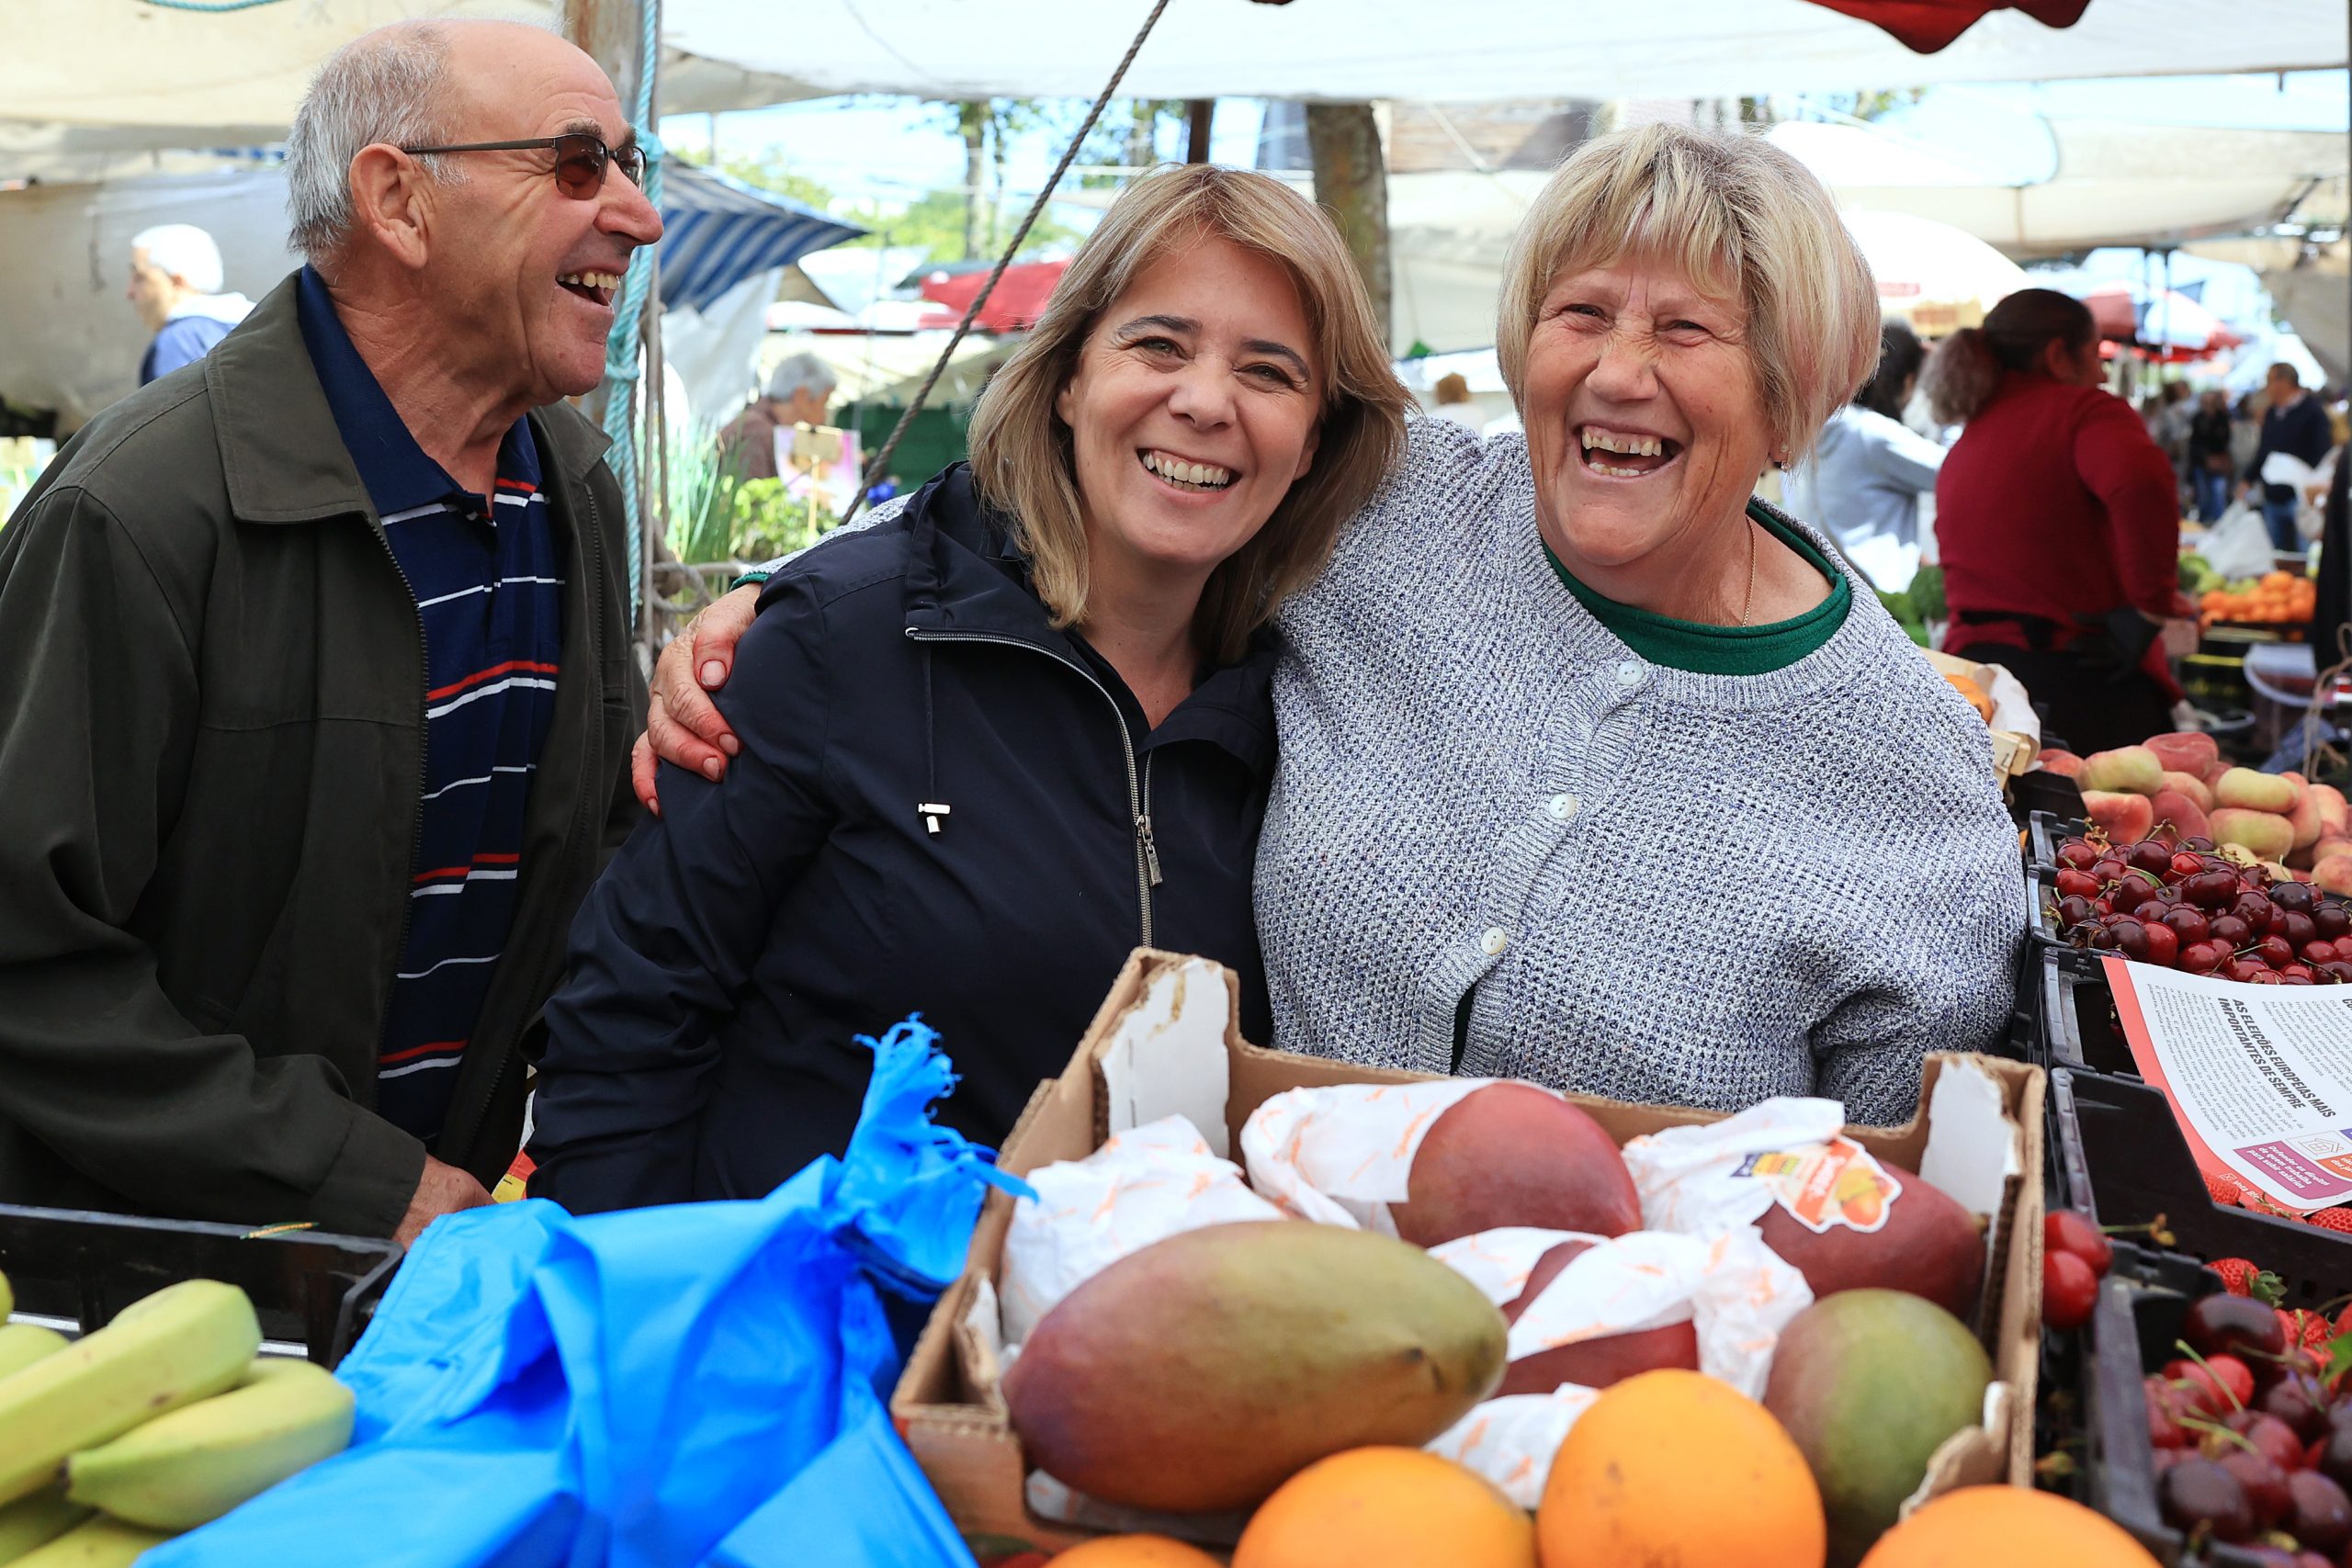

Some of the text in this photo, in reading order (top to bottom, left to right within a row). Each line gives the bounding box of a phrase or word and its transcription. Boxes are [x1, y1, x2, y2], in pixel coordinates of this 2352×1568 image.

[2219, 998, 2305, 1108] IMPORTANTES DE SEMPRE
[2233, 999, 2335, 1117] AS ELEIÇÕES EUROPEIAS MAIS
[2246, 1150, 2305, 1189] para subir salários
[2267, 1154, 2286, 1166] quem
[2285, 1166, 2312, 1185] trabalha
[2268, 1146, 2297, 1165] Defender
[2304, 1171, 2330, 1186] direitos
